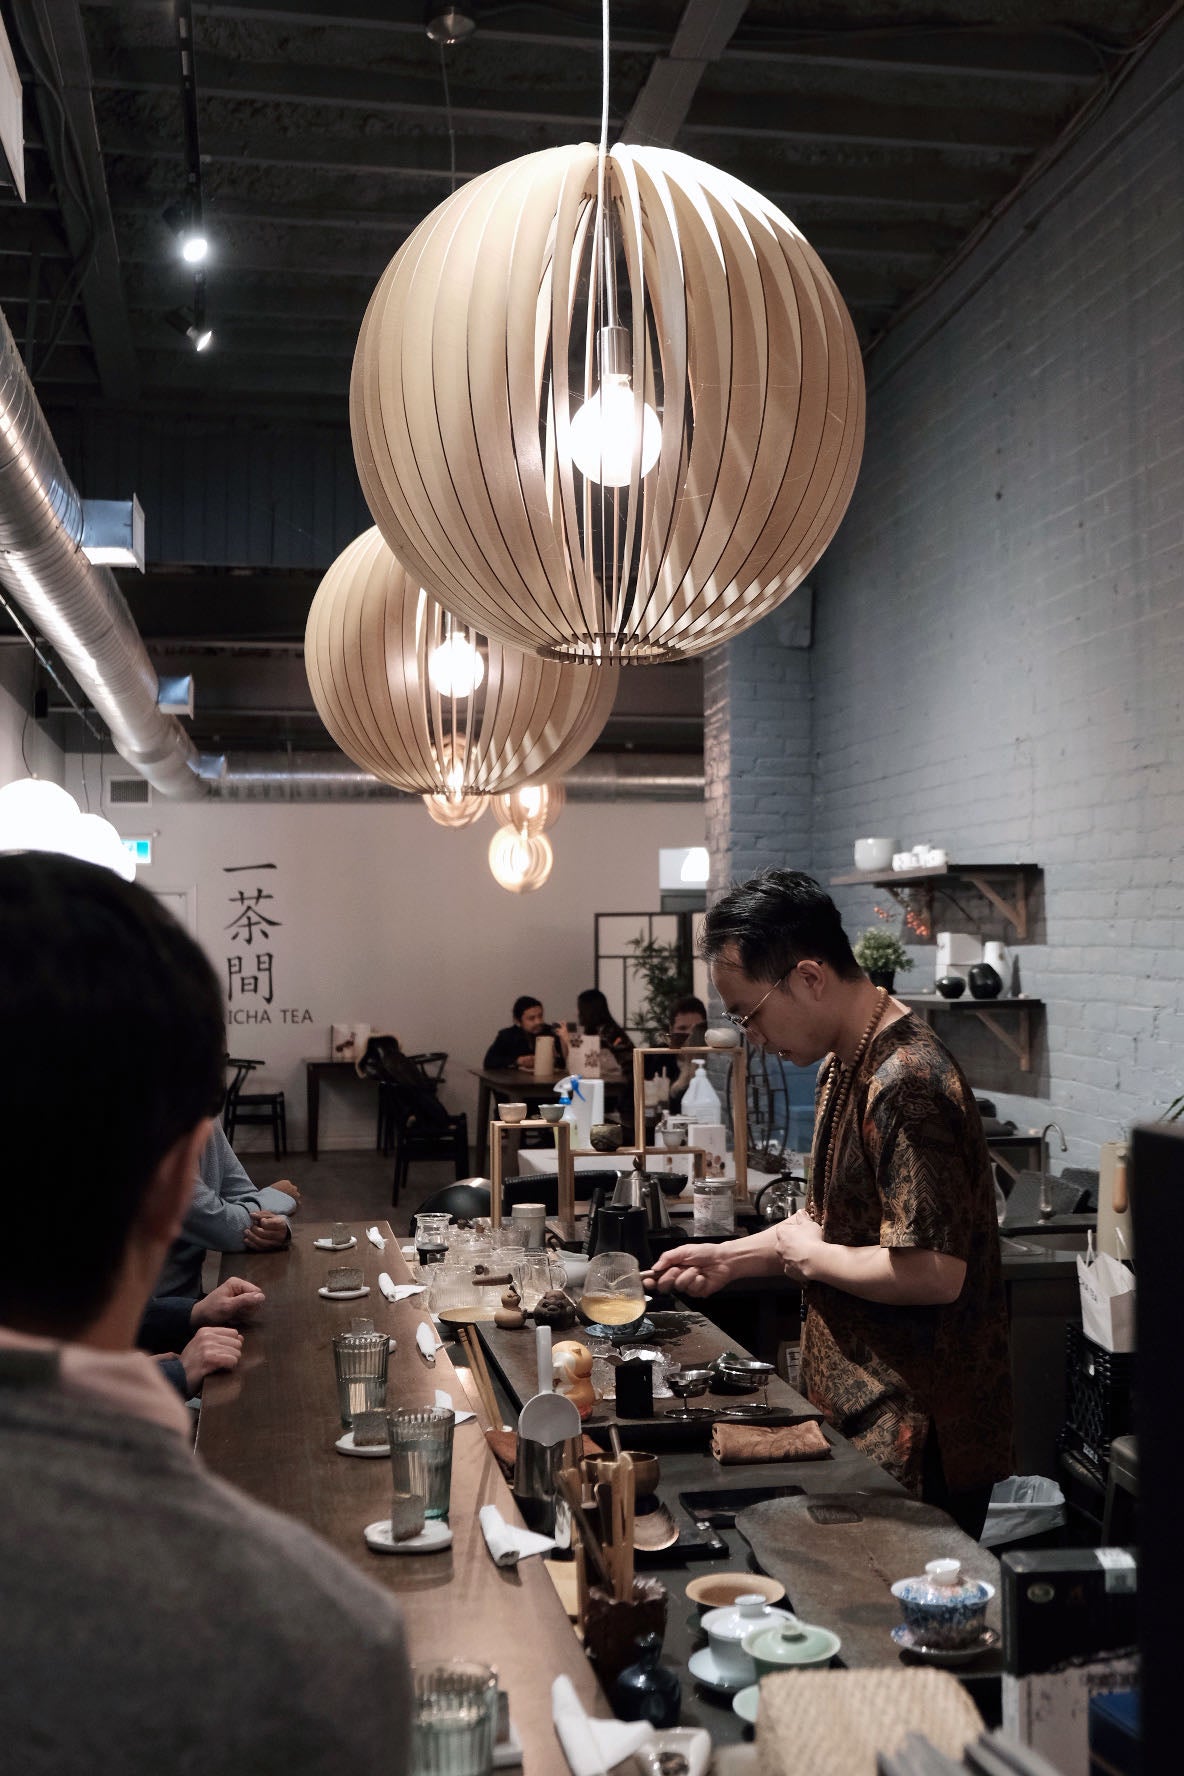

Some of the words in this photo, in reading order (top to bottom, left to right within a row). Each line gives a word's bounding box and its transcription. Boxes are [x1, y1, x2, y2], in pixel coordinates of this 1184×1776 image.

[222, 863, 283, 1004] 一茶間
[280, 1008, 314, 1025] TEA
